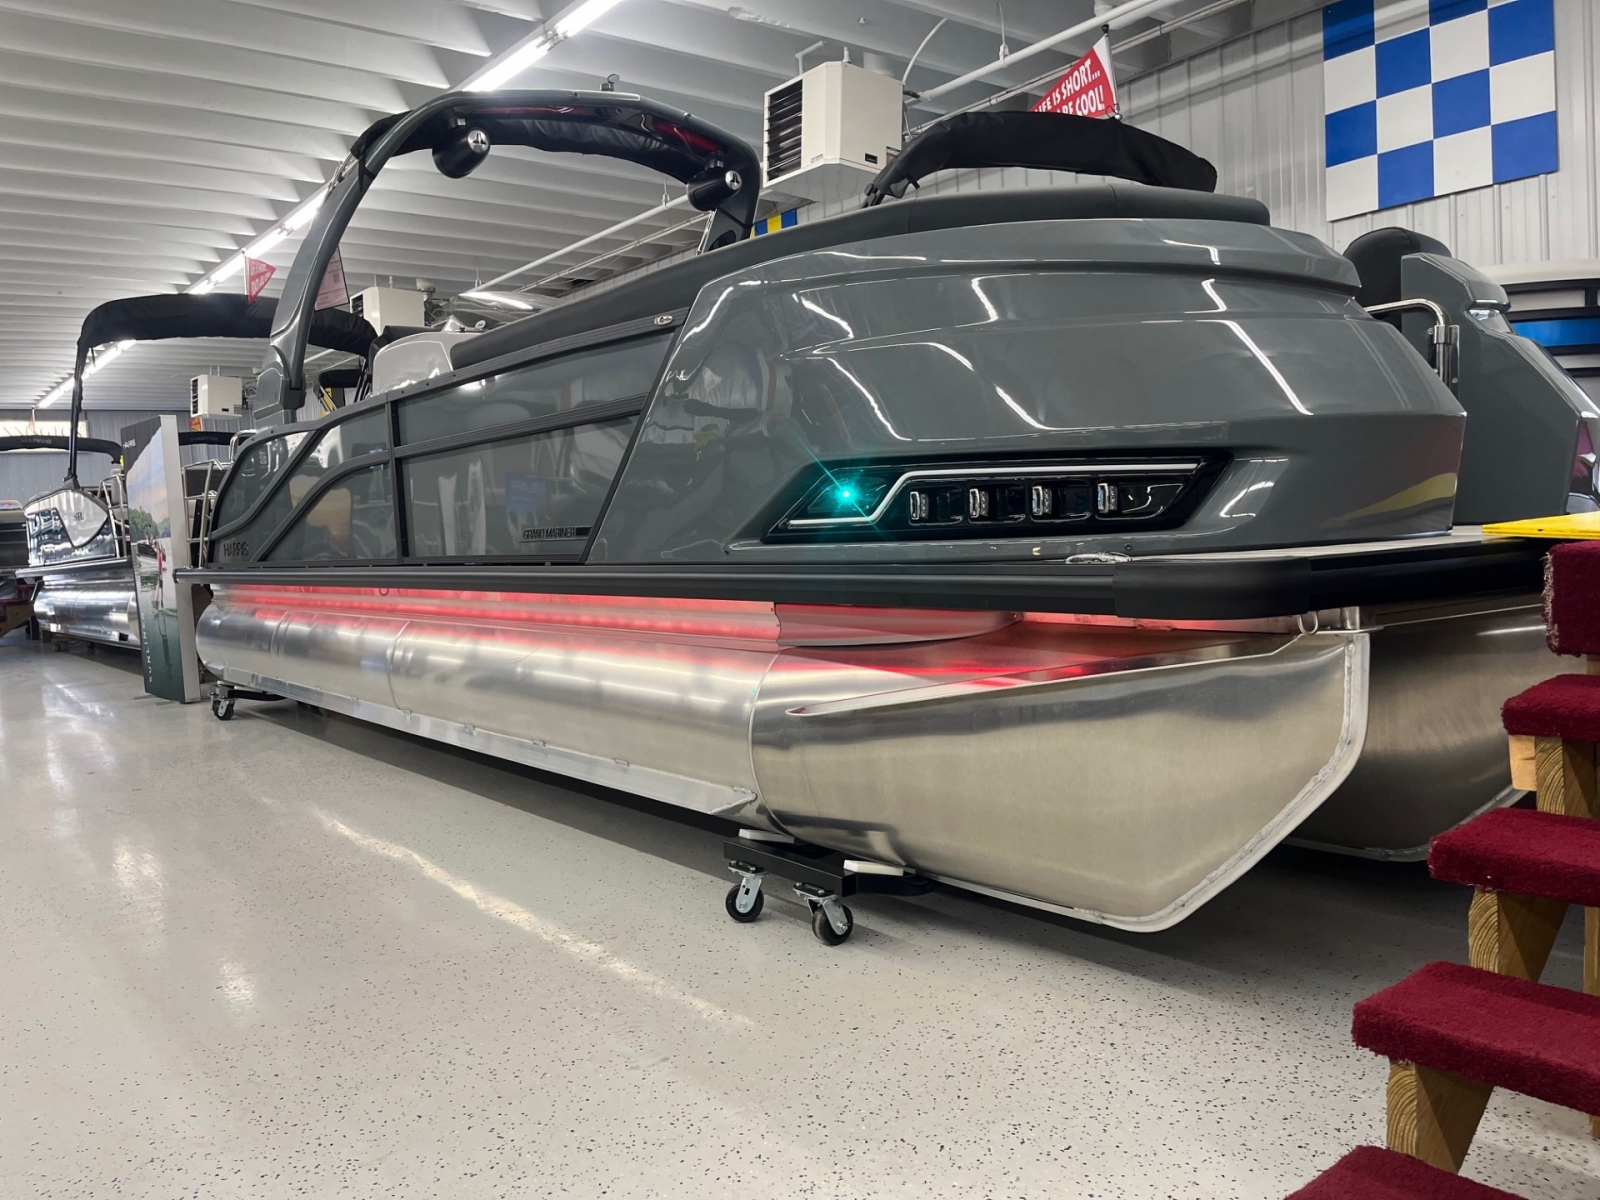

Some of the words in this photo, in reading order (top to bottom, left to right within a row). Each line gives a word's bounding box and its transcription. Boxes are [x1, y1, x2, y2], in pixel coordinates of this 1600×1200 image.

[1035, 96, 1052, 112] IFE
[1052, 87, 1061, 106] IS
[1061, 57, 1101, 100] SHORT...
[1075, 84, 1105, 116] COOL!
[524, 528, 545, 540] GRAND
[545, 526, 575, 539] MARINER
[223, 541, 248, 557] HARRIS
